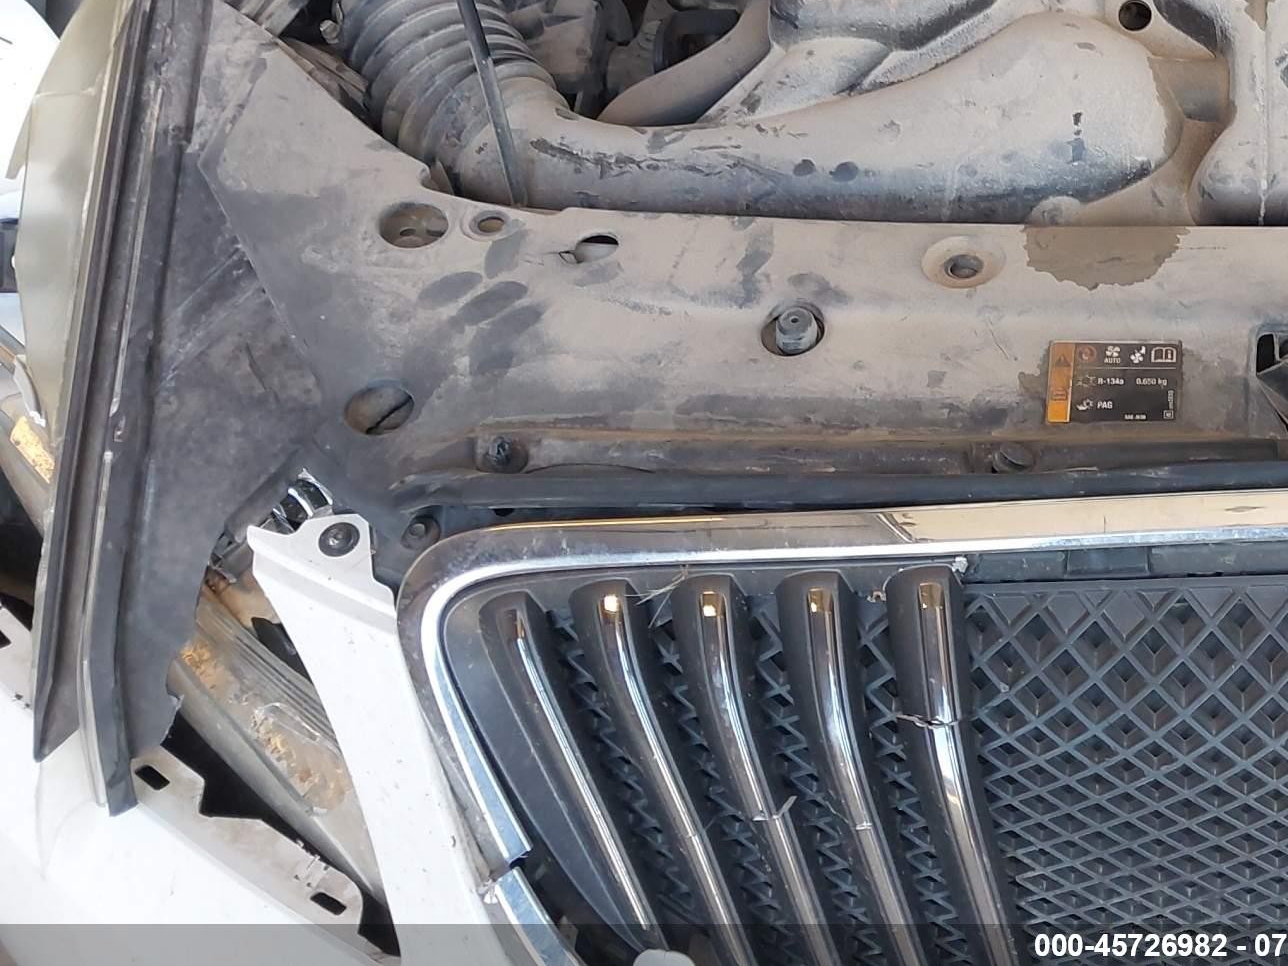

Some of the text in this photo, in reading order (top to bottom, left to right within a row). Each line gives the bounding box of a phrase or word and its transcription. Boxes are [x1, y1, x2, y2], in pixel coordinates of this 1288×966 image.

[1097, 377, 1125, 385] R-134a
[1157, 377, 1168, 386] kg
[1097, 400, 1113, 409] PAG
